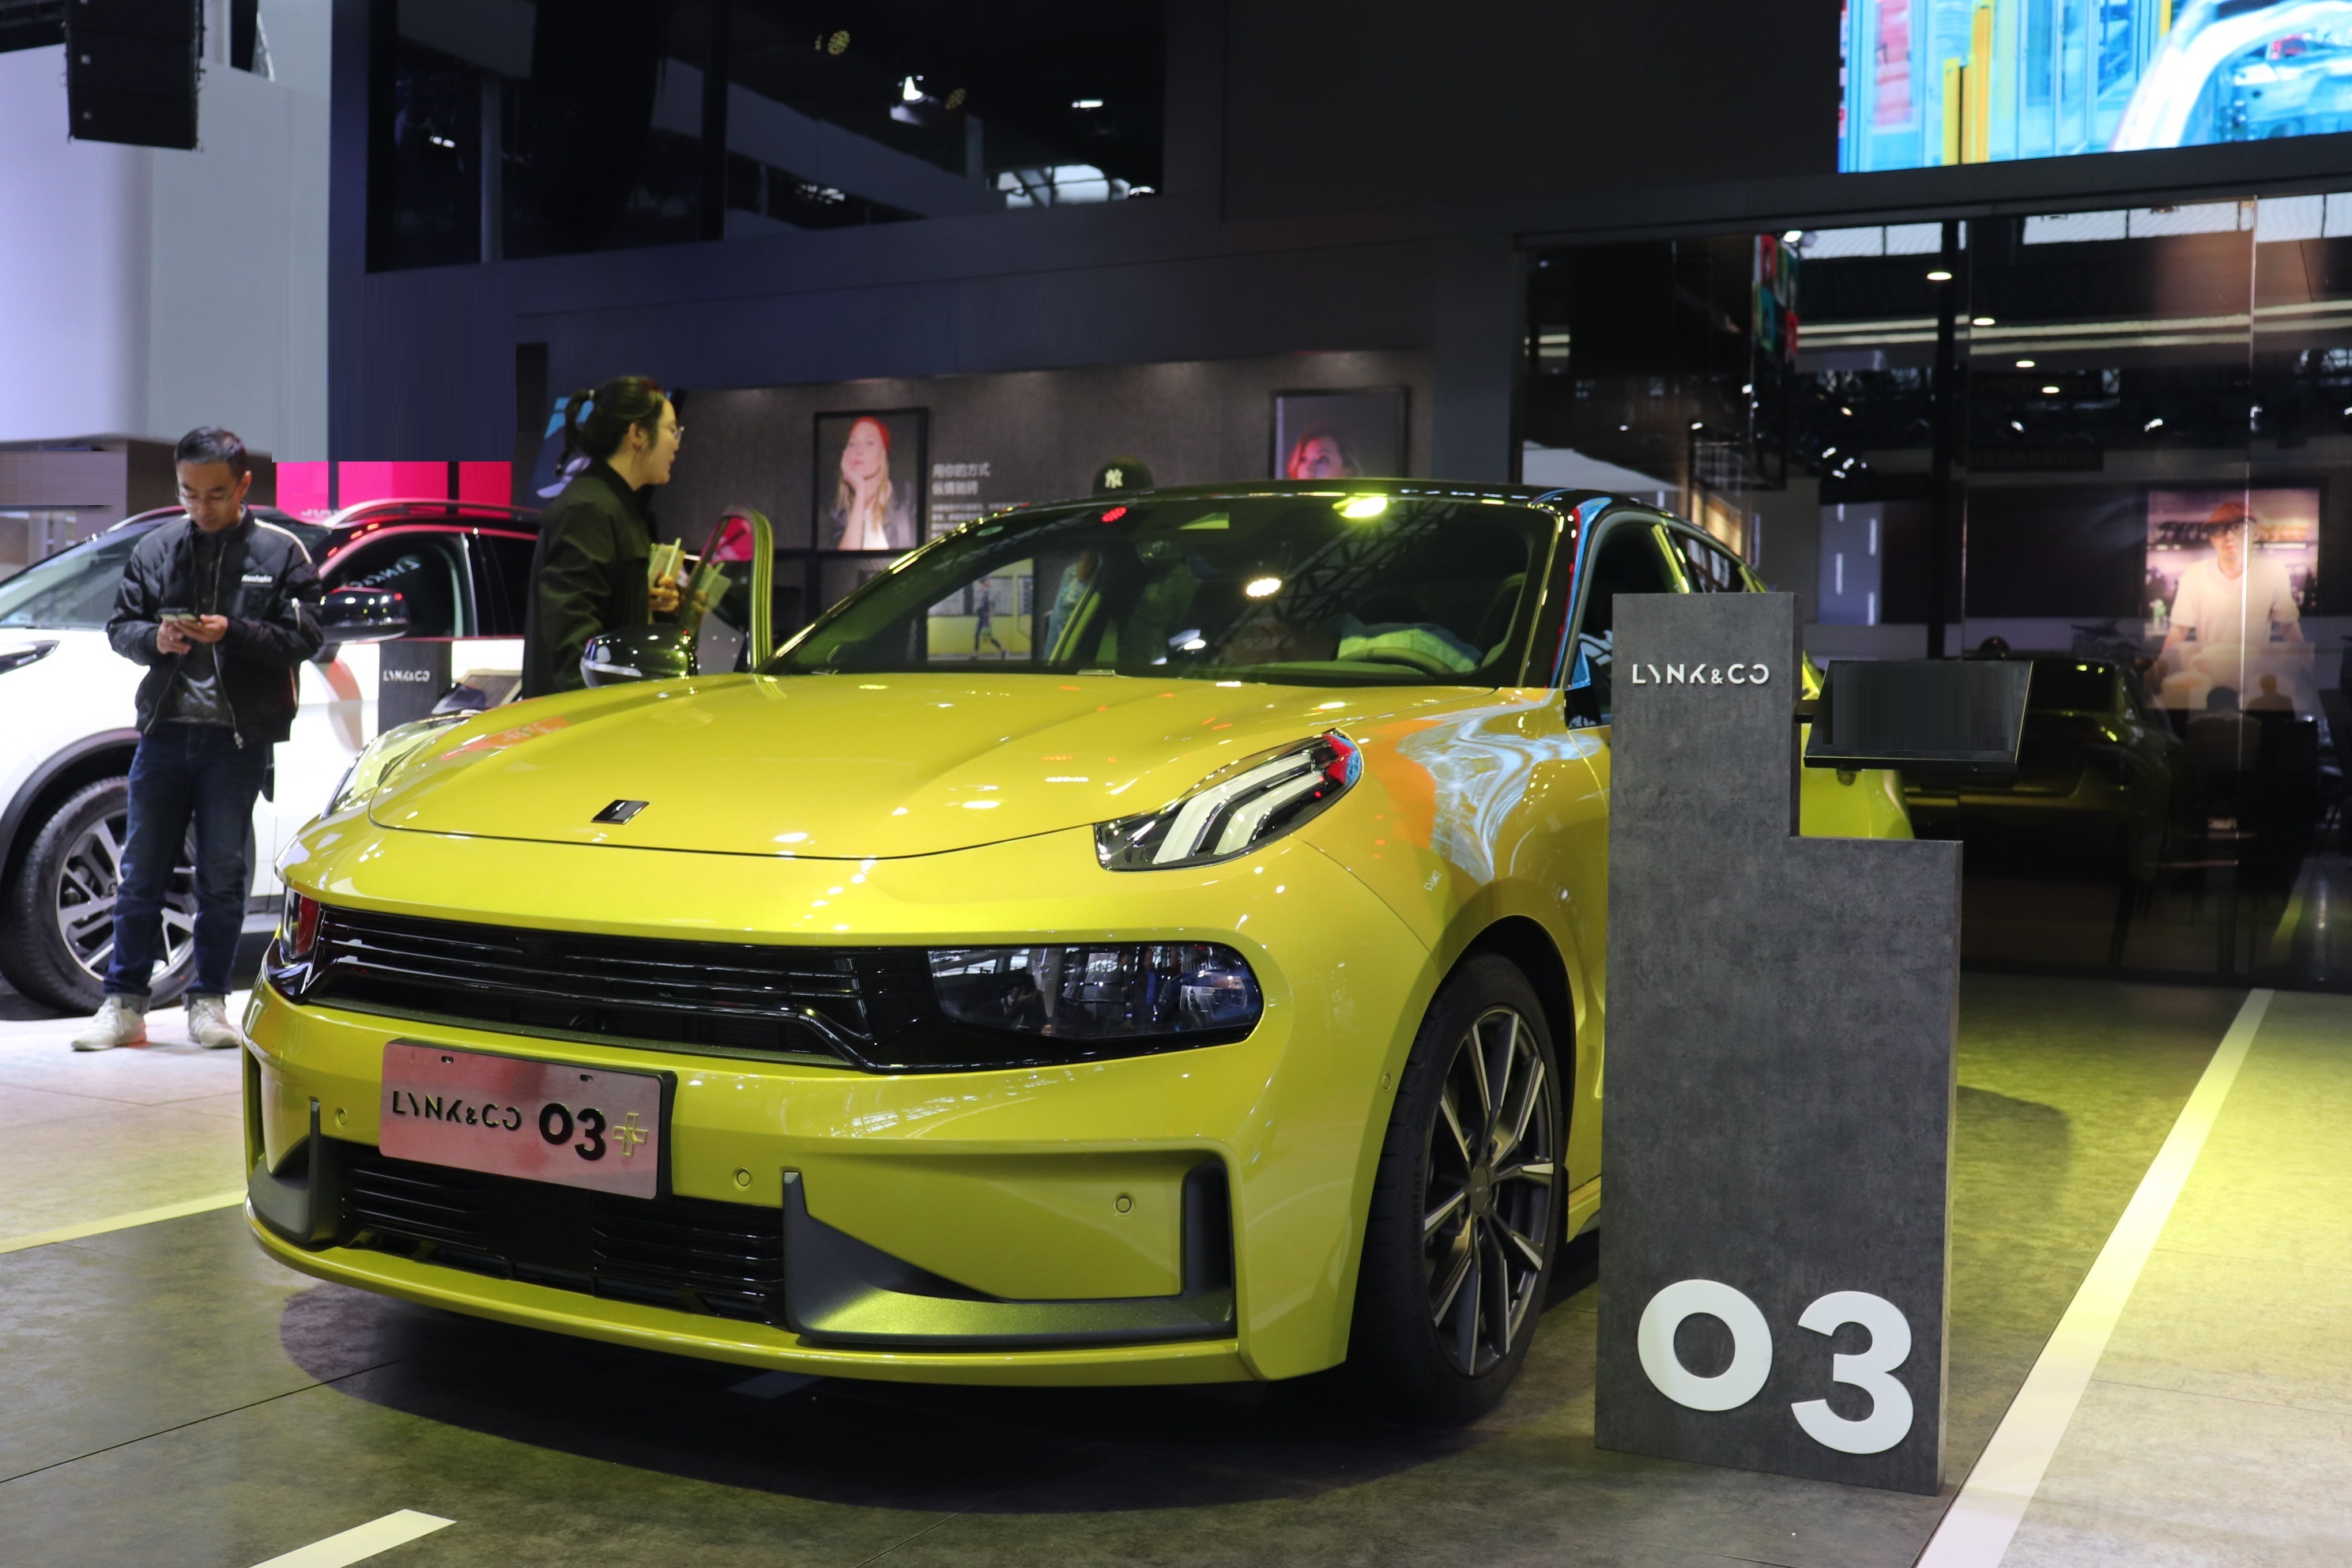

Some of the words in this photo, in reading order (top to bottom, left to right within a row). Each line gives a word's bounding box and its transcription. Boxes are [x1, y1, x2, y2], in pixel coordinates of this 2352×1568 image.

[1632, 663, 1770, 684] LYNK&CO
[392, 1090, 522, 1131] LYNK&CO
[1638, 1279, 1913, 1454] 03
